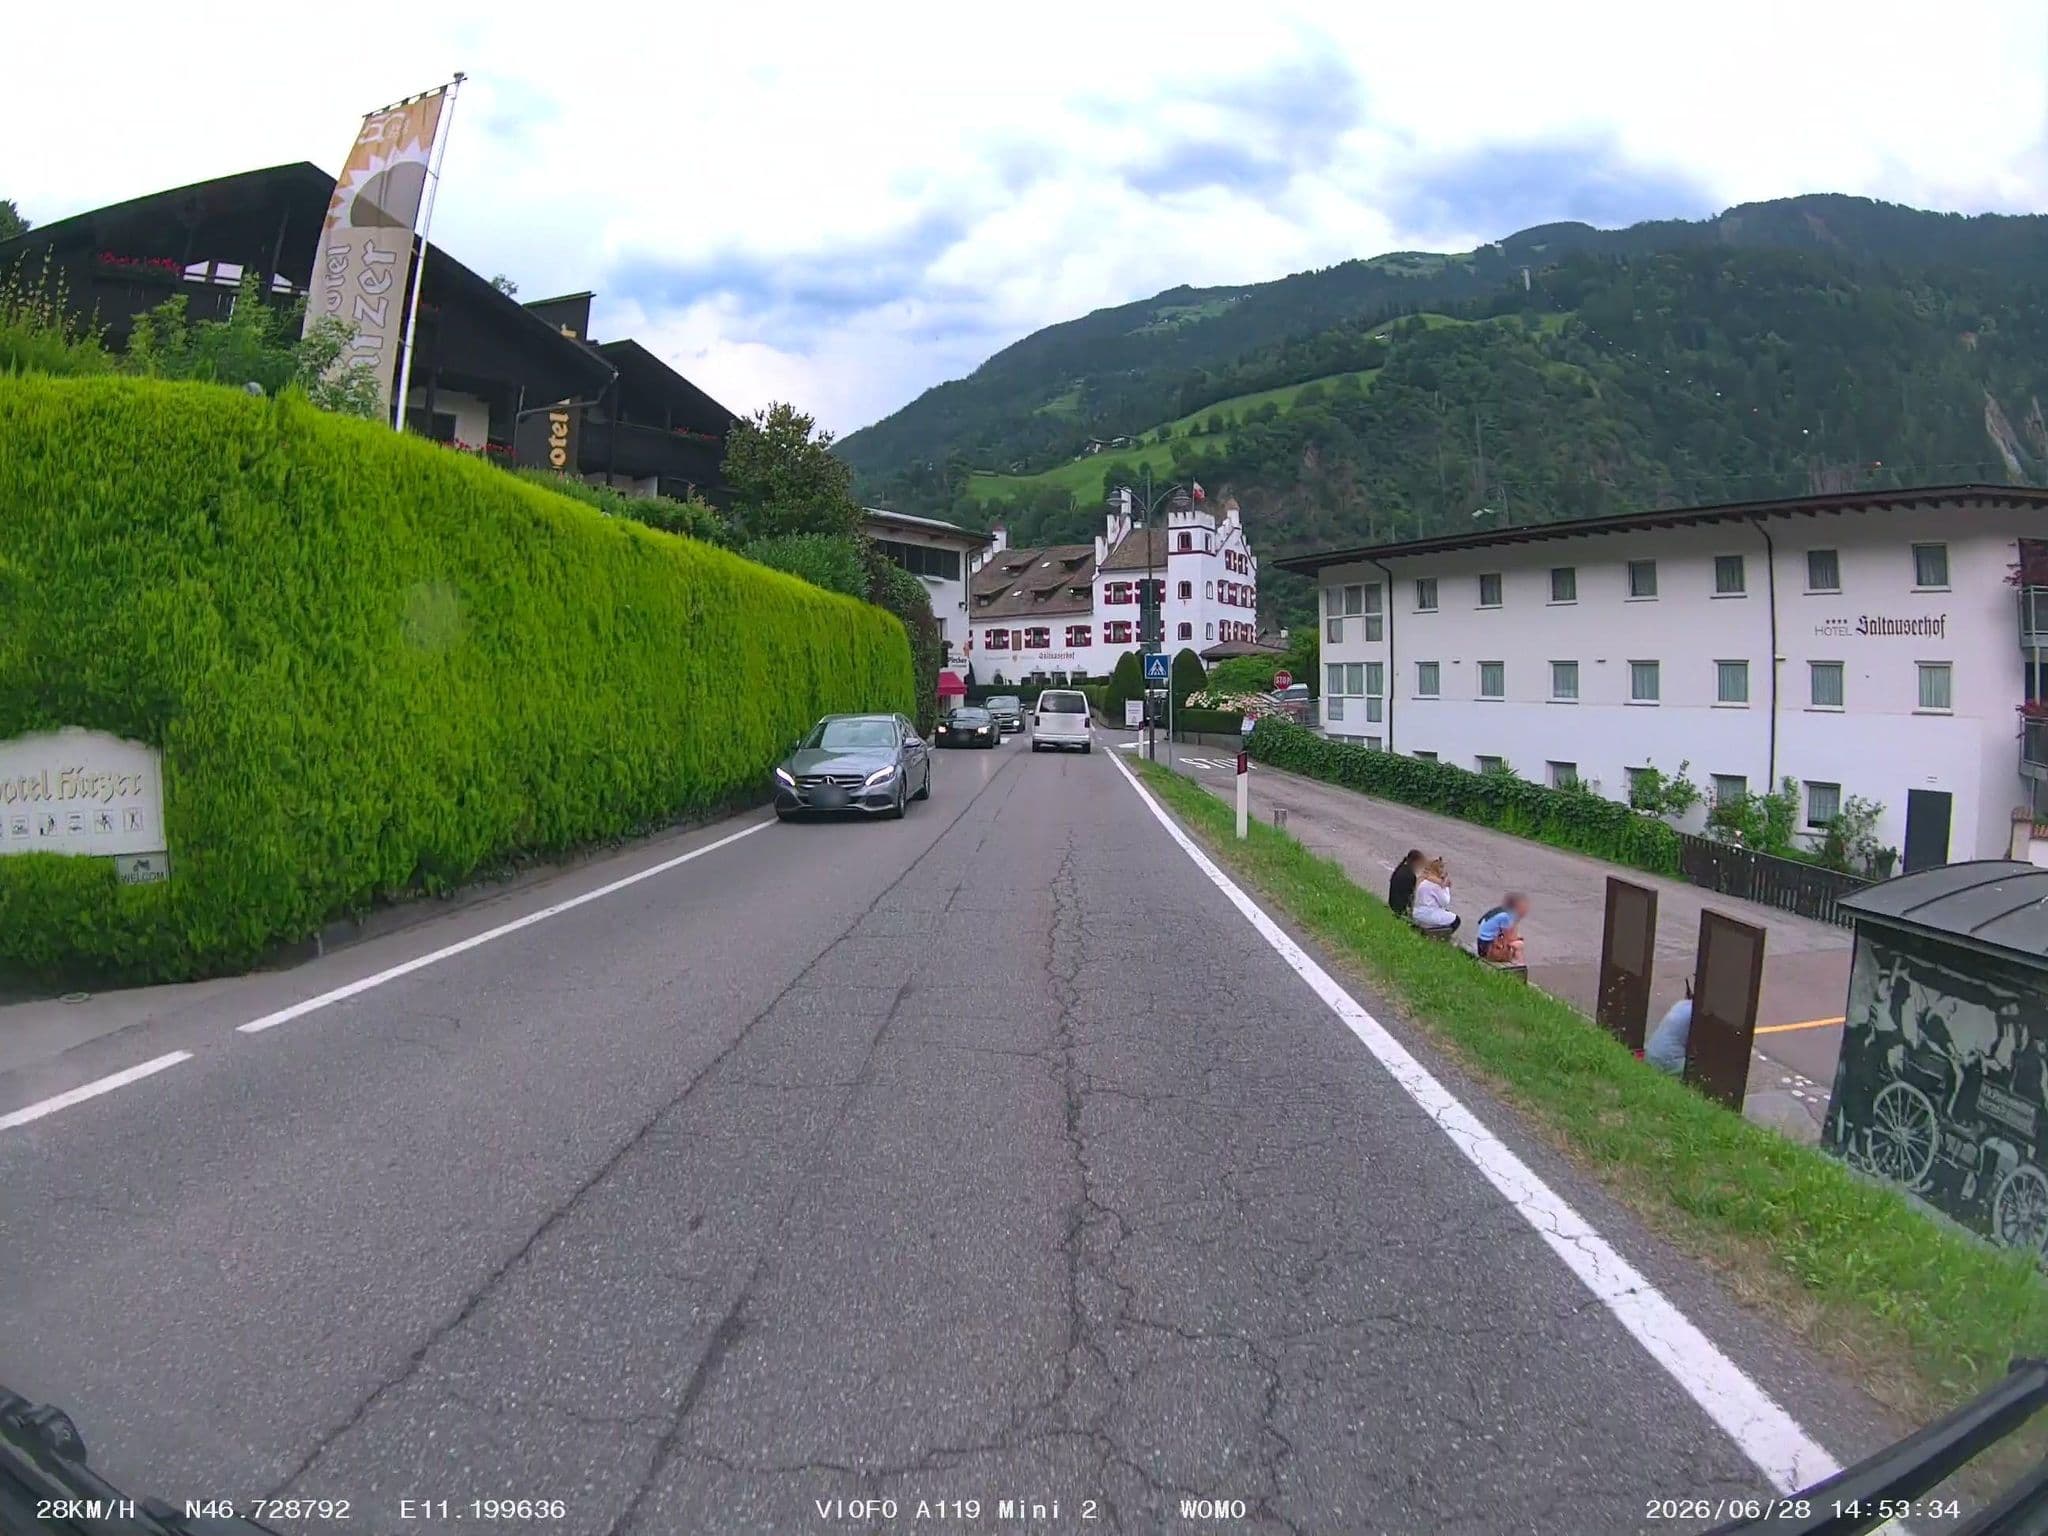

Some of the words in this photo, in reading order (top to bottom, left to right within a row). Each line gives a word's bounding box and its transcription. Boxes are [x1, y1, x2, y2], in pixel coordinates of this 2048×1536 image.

[323, 245, 351, 317] otel
[548, 399, 569, 469] otel
[1814, 625, 1853, 637] HOTEL
[1856, 614, 1947, 640] Saltauserhof
[1275, 675, 1290, 685] STOP
[0, 766, 52, 804] otel
